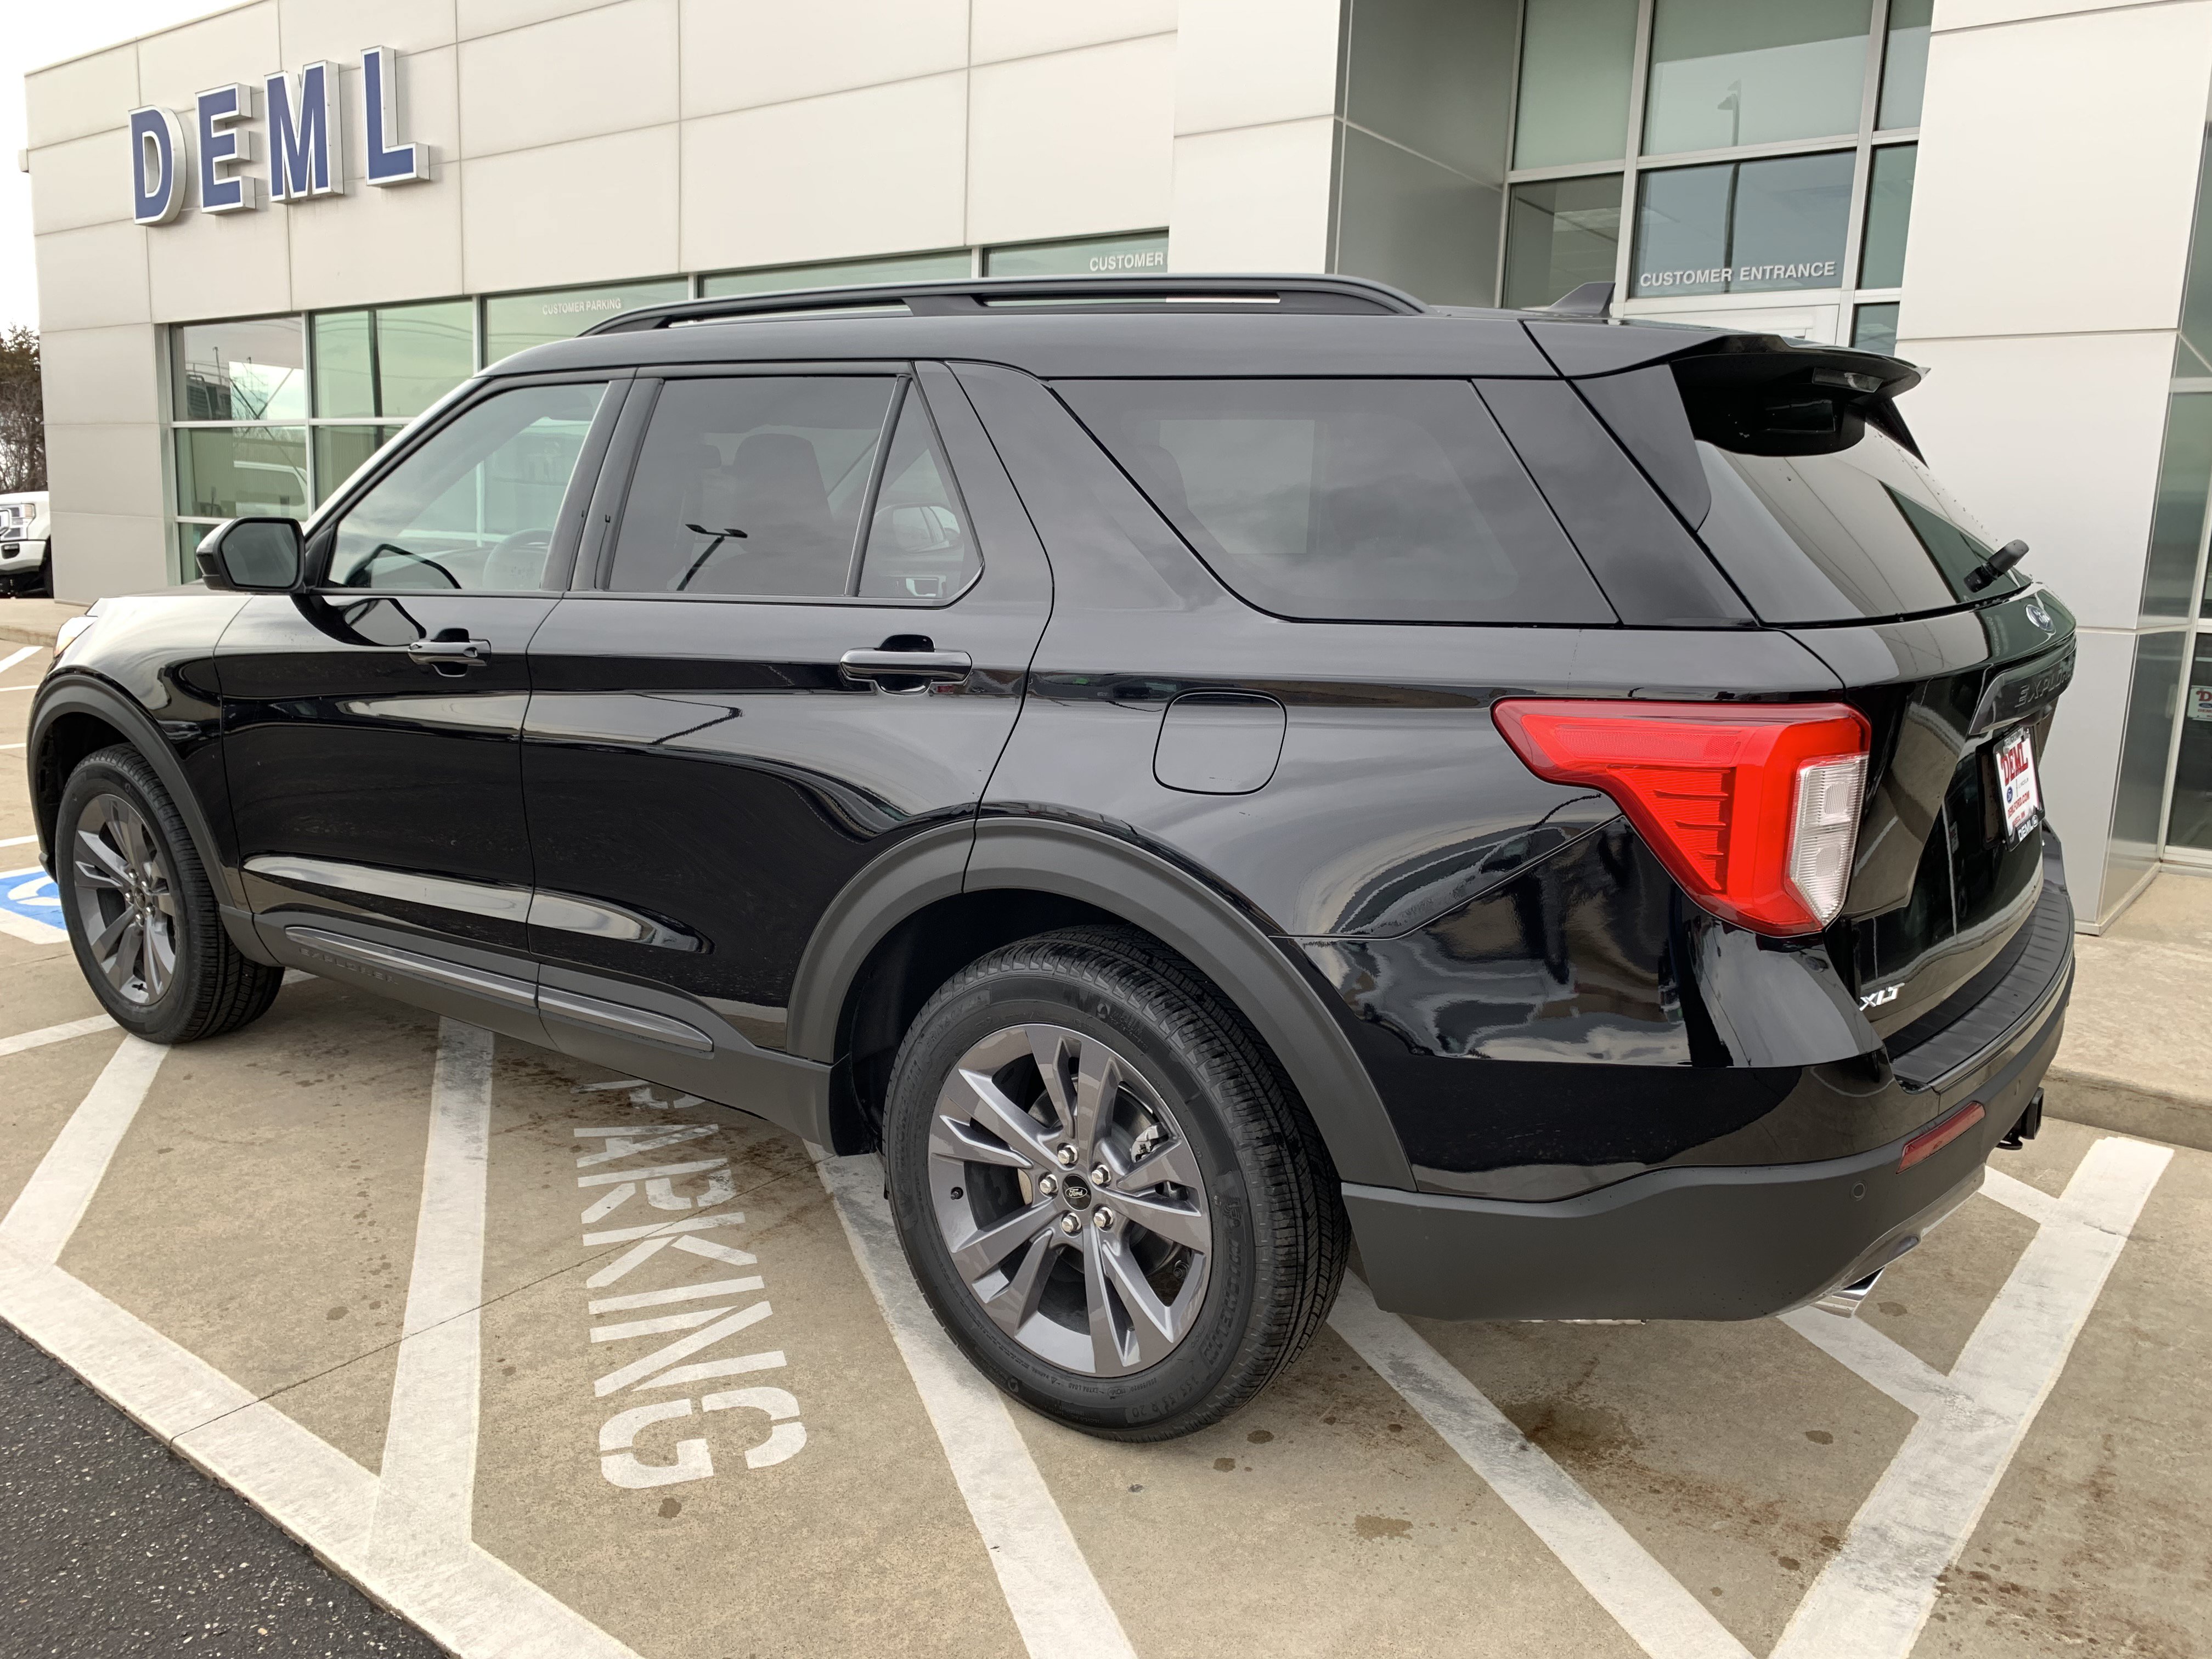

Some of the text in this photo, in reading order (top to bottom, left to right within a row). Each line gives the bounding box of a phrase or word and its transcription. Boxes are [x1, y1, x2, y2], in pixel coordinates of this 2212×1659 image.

[128, 45, 430, 225] DEML
[1090, 252, 1163, 272] CUSTOMER
[1640, 261, 1836, 287] CUSTOMER ENTRANCE
[543, 298, 622, 315] CUSTOMER PARKING
[2000, 742, 2029, 786] DEML
[2018, 820, 2034, 842] DEML
[1859, 983, 1905, 1011] XLT
